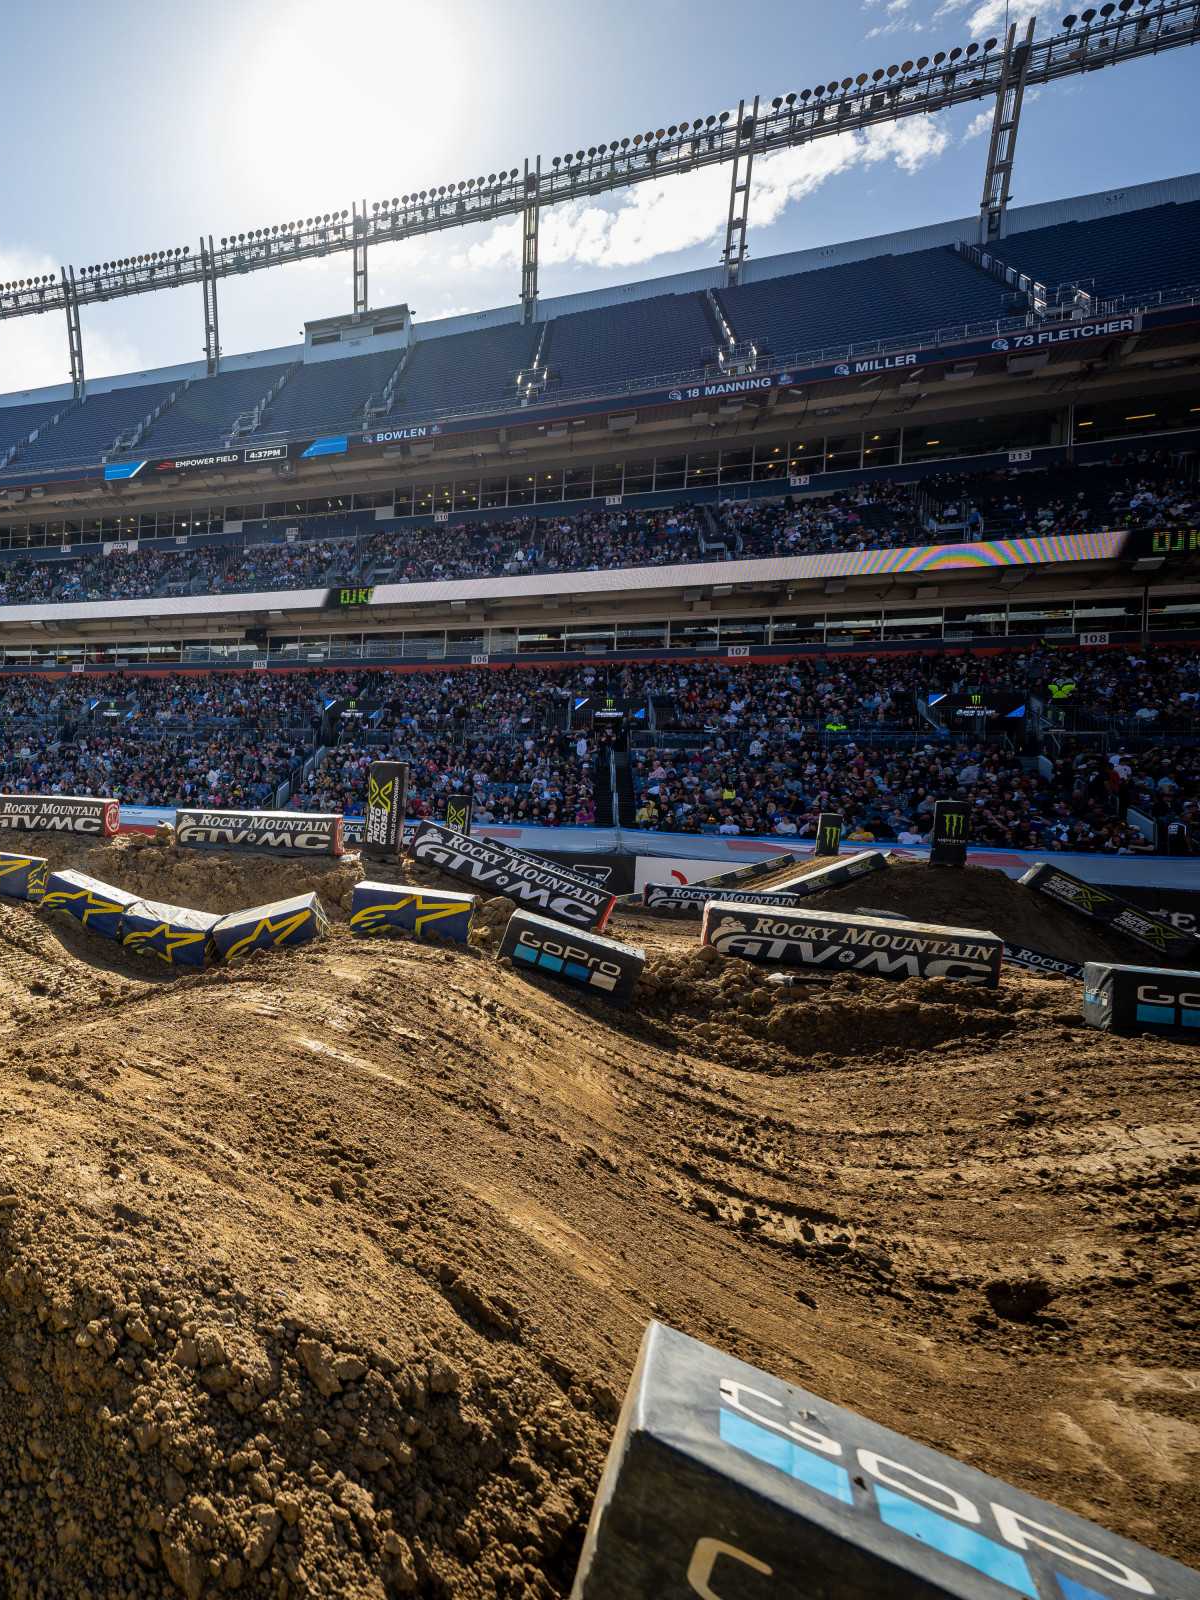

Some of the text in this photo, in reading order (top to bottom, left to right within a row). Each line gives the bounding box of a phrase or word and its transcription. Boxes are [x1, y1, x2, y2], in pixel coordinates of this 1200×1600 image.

[1013, 319, 1133, 348] 73 FLETCHER
[855, 354, 917, 373] MILLER
[686, 377, 772, 397] 18 MANNING
[376, 427, 426, 442] BOWLEN
[175, 454, 238, 468] EMPOWER FIELD
[249, 448, 281, 459] 4:37PM
[1009, 452, 1031, 462] 313
[791, 476, 809, 486] 312
[605, 496, 622, 505] 311
[113, 542, 128, 550] KOA
[1082, 633, 1107, 644] 108
[473, 655, 488, 663] 106
[729, 647, 748, 656] 107
[2, 802, 103, 817] ROCKY MOUNTAIN
[45, 816, 102, 832] MC
[198, 814, 332, 832] ROCKY MOUNTAIN
[366, 805, 377, 843] SUPER
[373, 808, 382, 842] MOTO
[380, 808, 389, 845] CROSS
[180, 827, 331, 849] ATV MC
[443, 835, 605, 906] ROCKY MOUNTAIN
[502, 846, 603, 890] ROCKY MOUNTAIN
[416, 844, 598, 922] ATV MC
[670, 888, 798, 907] ROCKY MOUNTAIN
[751, 917, 997, 961] ROCKY MOUNTAIN
[519, 930, 622, 976] GoPro
[716, 934, 993, 983] ATV MC
[1015, 948, 1076, 973] ROCKY
